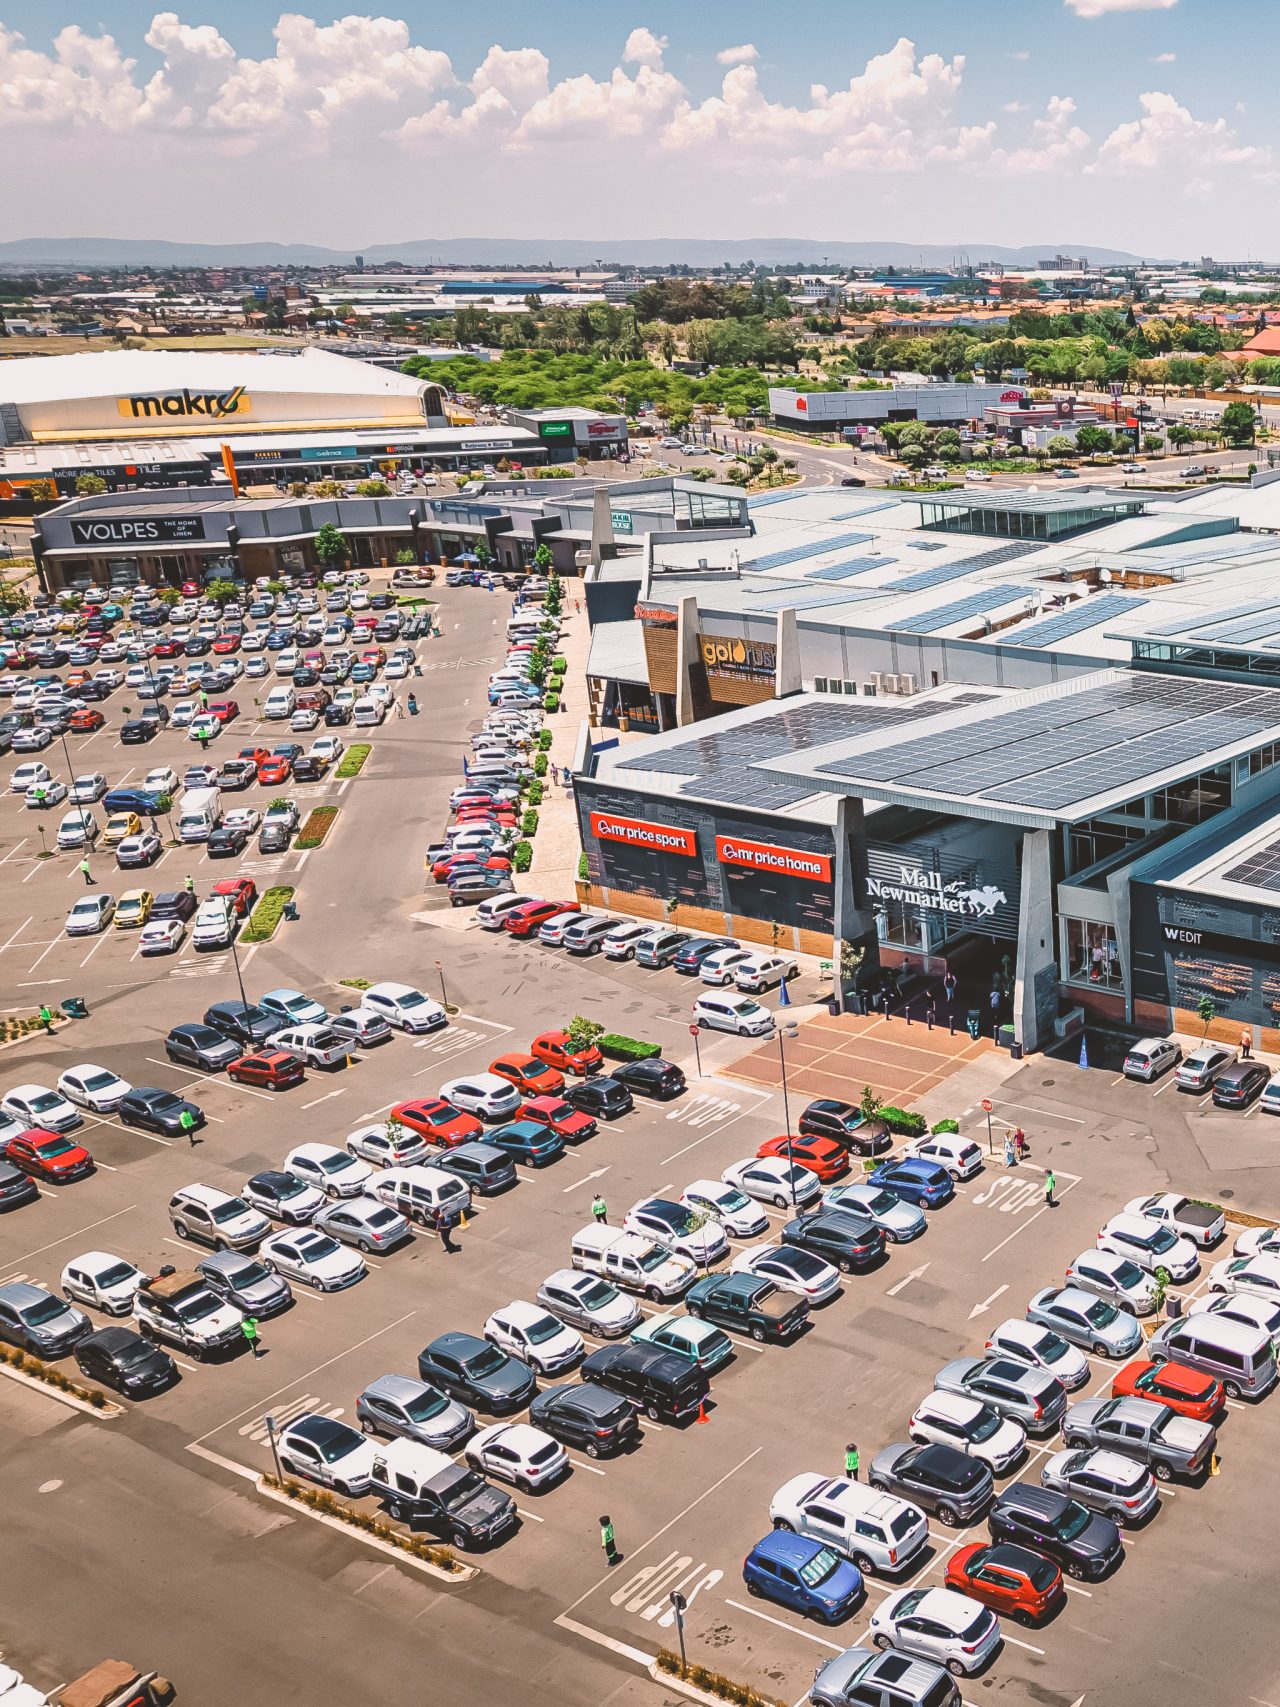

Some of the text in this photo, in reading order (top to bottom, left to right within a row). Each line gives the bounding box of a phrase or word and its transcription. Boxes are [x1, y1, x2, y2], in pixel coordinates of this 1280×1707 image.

[131, 387, 239, 417] makro
[95, 468, 116, 476] TILES
[77, 522, 159, 540] VOLPES
[655, 833, 687, 849] sport
[786, 855, 822, 875] home
[899, 866, 966, 894] Mall at
[865, 877, 967, 915] Newmarket
[1164, 927, 1203, 945] W EDIT
[666, 1094, 741, 1128] STOP
[972, 1175, 1047, 1215] STOP
[609, 1550, 724, 1627] STOP
